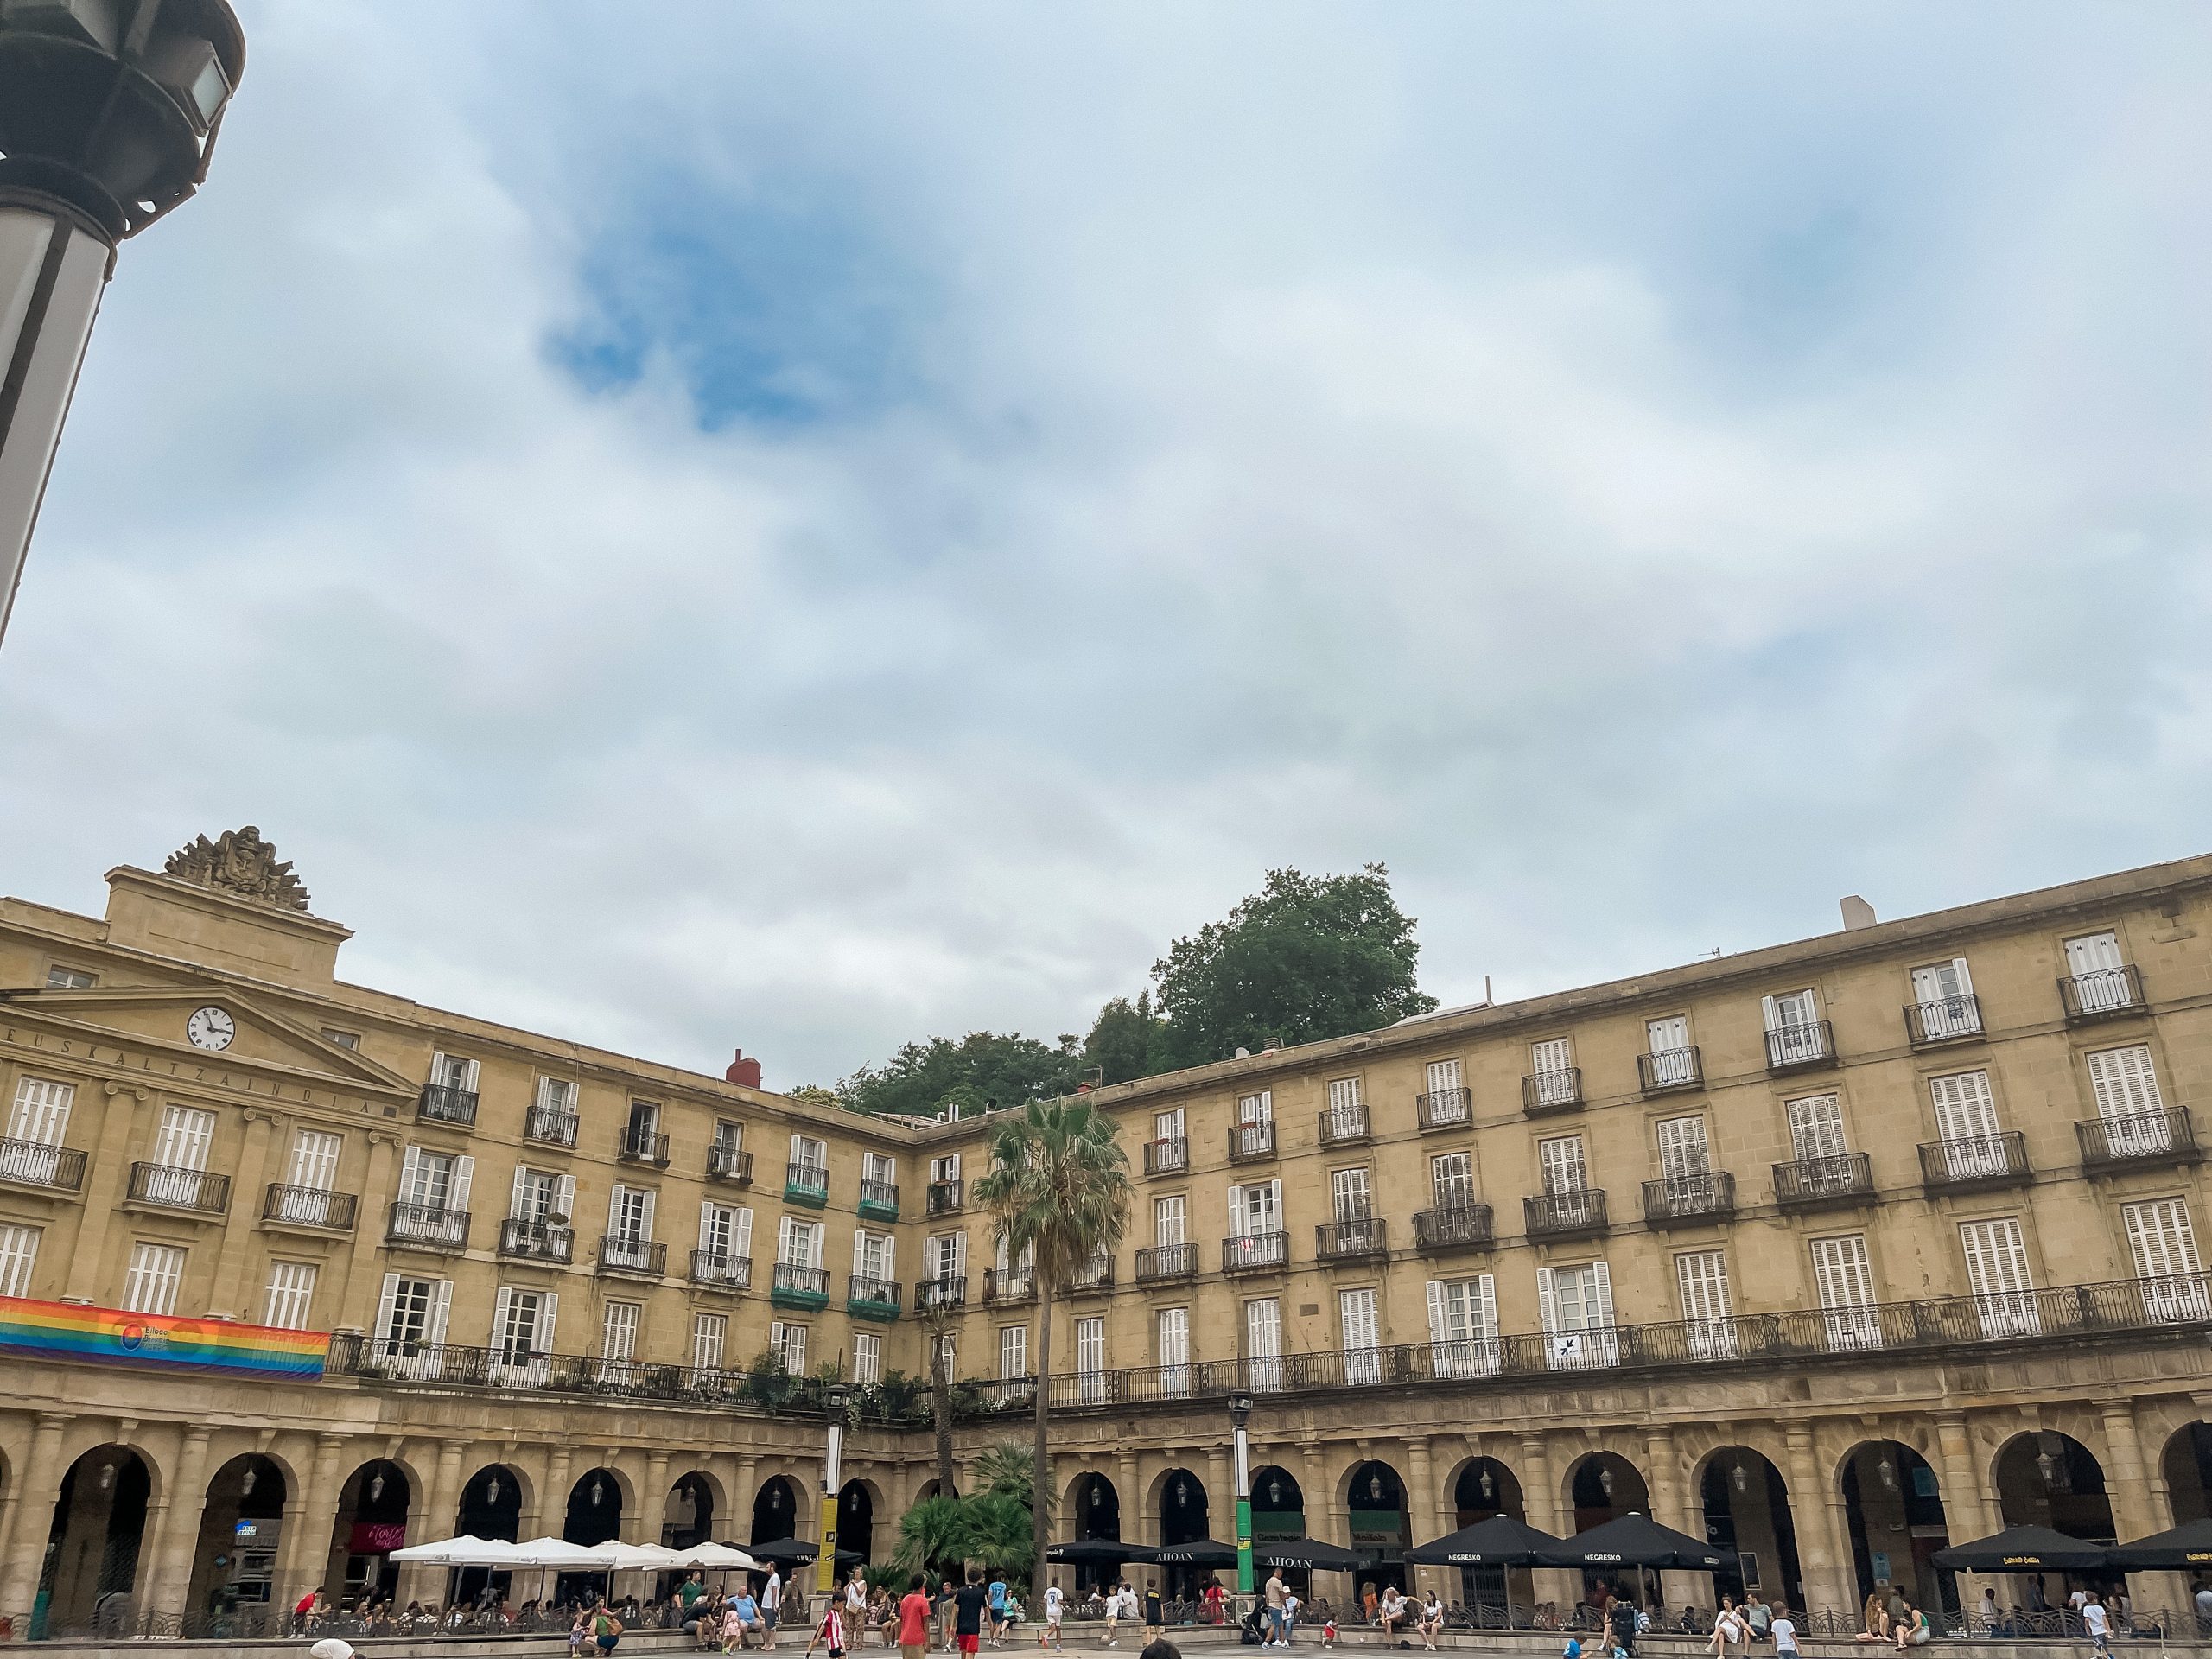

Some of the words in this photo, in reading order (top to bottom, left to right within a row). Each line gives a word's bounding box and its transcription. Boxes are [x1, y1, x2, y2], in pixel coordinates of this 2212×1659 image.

[6, 1028, 370, 1114] EUSKALTZAINDIA
[145, 1326, 168, 1335] Bilbao
[1050, 1595, 1056, 1605] 9
